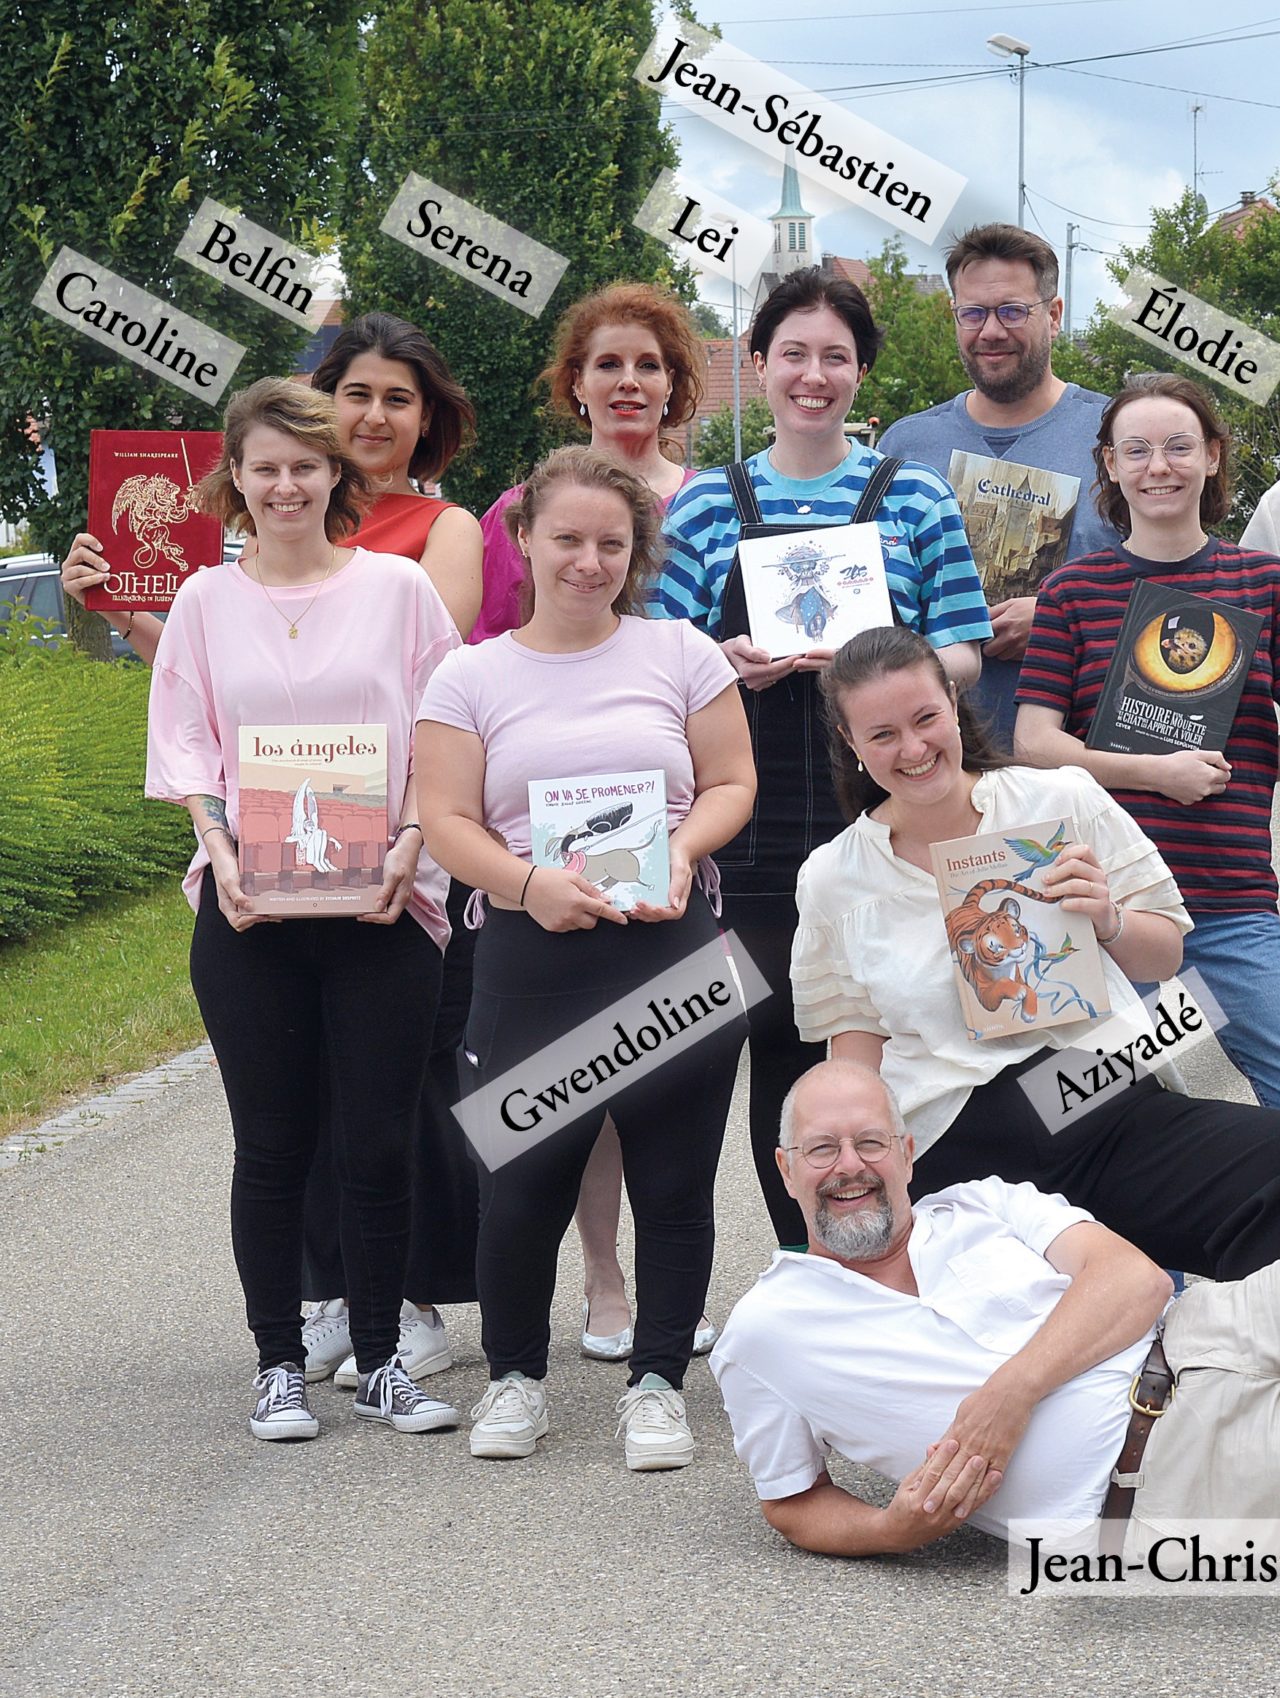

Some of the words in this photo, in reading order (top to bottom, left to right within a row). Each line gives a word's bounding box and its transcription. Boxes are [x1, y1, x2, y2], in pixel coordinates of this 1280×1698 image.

[978, 478, 1050, 506] Cathedral
[104, 572, 180, 594] OTHELL
[1120, 696, 1172, 724] HISTOIRE
[1170, 713, 1207, 736] MOUETTE
[1123, 713, 1142, 727] CHAT
[1147, 720, 1174, 736] APPRIT
[1181, 730, 1203, 746] VOLER
[253, 736, 283, 756] los
[290, 735, 377, 763] ángeles
[544, 790, 559, 802] ON
[562, 789, 573, 801] VA
[575, 788, 589, 800] SE
[591, 781, 655, 798] PROMENER?!
[946, 850, 1006, 871] Instants
